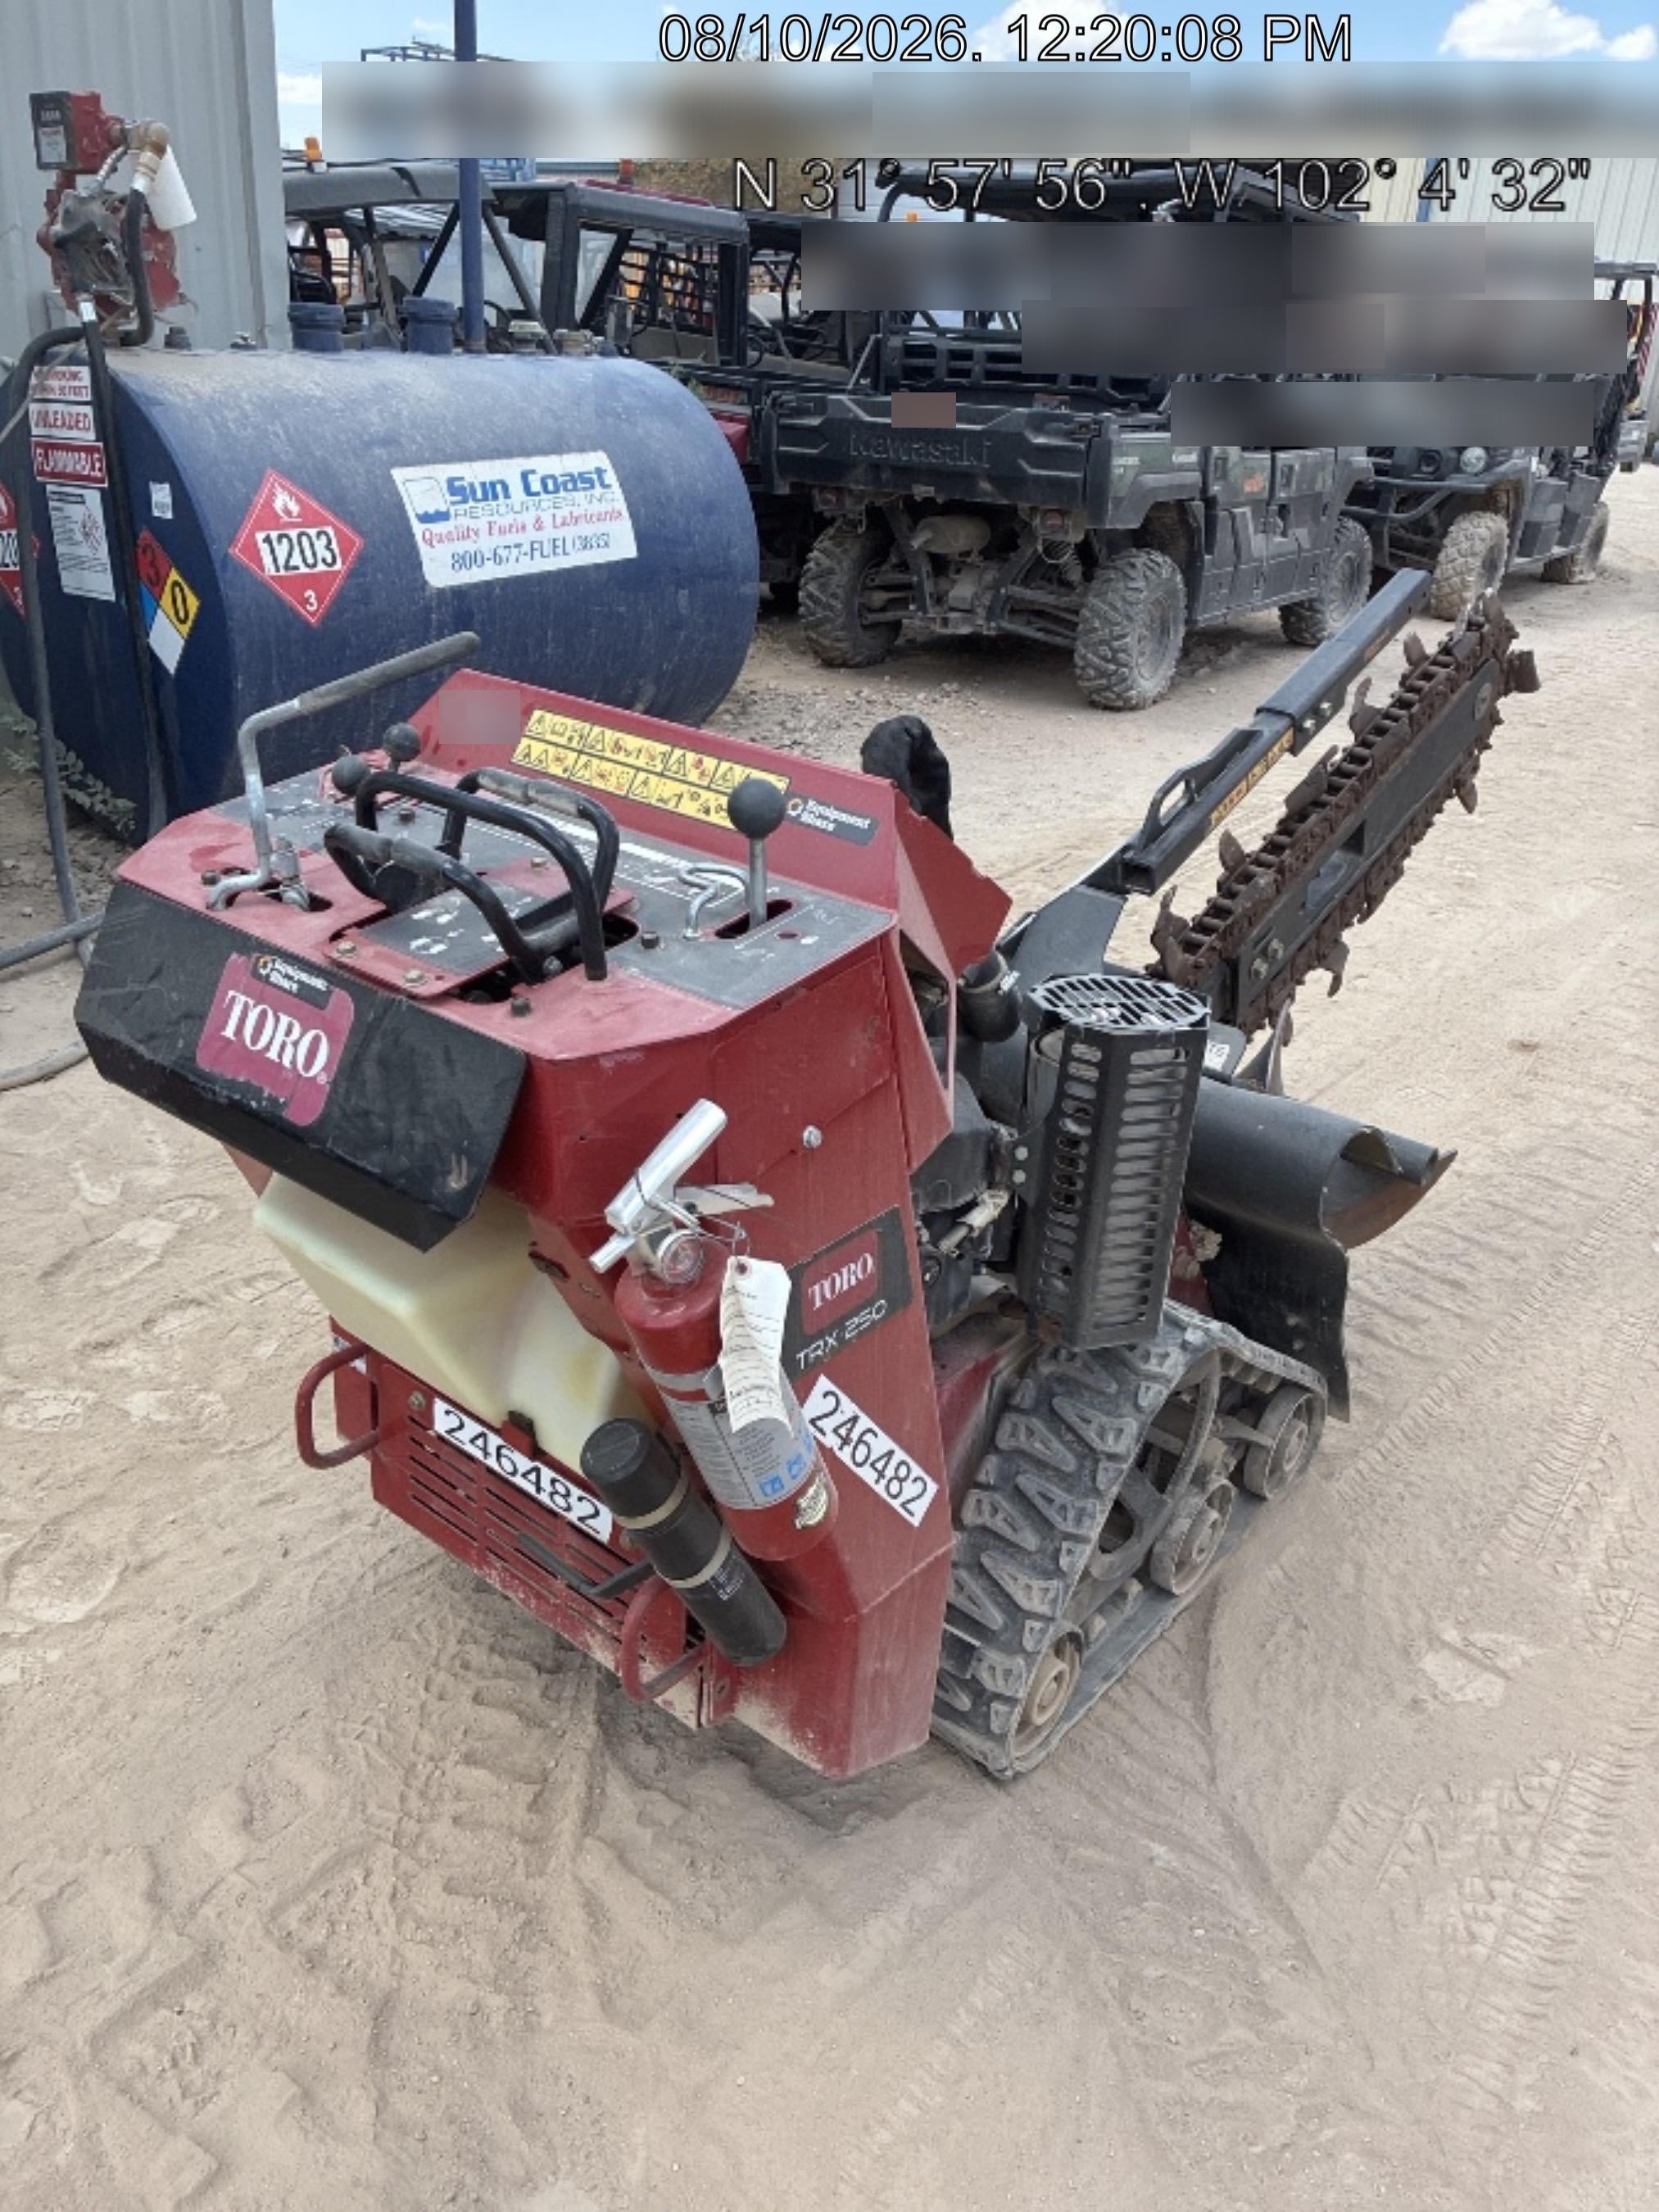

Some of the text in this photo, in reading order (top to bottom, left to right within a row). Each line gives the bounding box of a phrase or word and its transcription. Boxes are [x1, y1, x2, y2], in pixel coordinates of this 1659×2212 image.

[36, 447, 102, 477] FLAMMABLE
[850, 433, 991, 468] Kawasaki
[446, 466, 613, 505] Sun Coast
[422, 525, 480, 549] Quality
[532, 517, 546, 533] &
[552, 508, 624, 530] Lubricants
[454, 496, 581, 520] RESOURCES,
[143, 543, 160, 587] 3
[262, 530, 338, 573] 1203
[451, 535, 570, 572] 800-677-FUEL
[171, 579, 189, 625] 0
[304, 588, 318, 611] 3
[220, 990, 329, 1077] TORO
[808, 1253, 876, 1311] TORO
[796, 1299, 887, 1369] TRX 250
[444, 1409, 601, 1535] 246482
[808, 1390, 927, 1517] 246482
